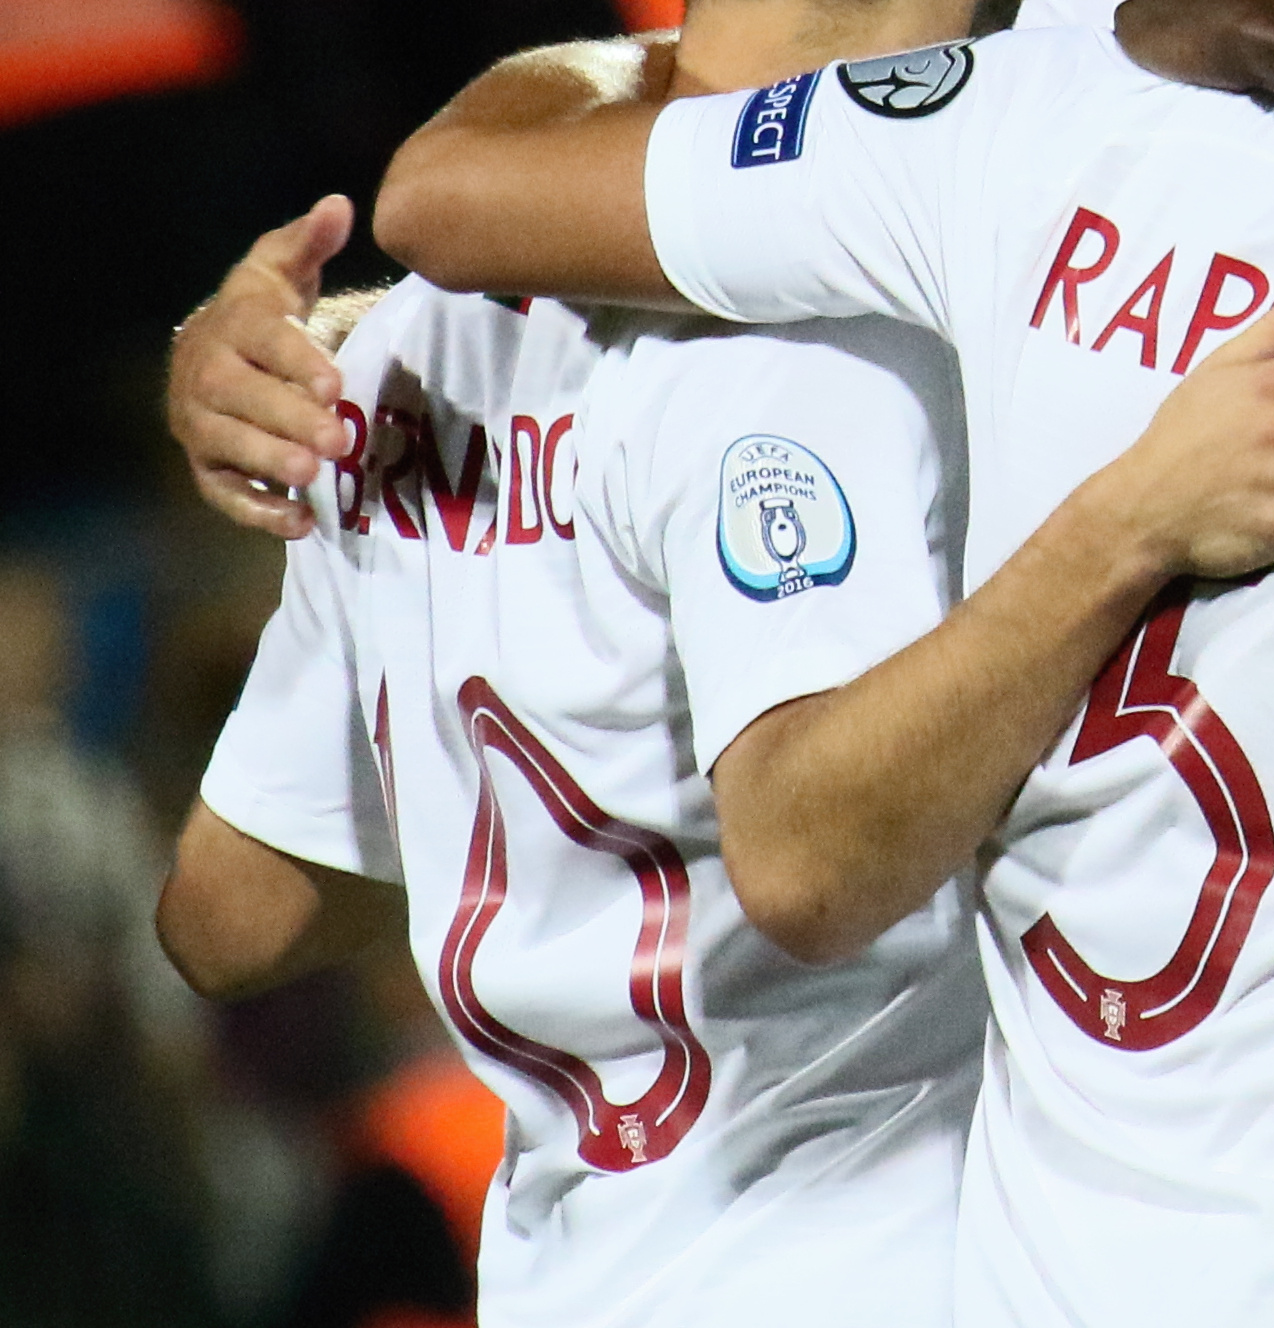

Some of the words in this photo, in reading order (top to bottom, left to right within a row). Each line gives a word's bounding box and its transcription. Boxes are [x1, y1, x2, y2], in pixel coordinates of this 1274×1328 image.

[741, 444, 790, 463] UEFA
[730, 467, 815, 493] EUROPEAN
[735, 483, 817, 508] CHAMPIONS
[777, 577, 814, 599] 2016
